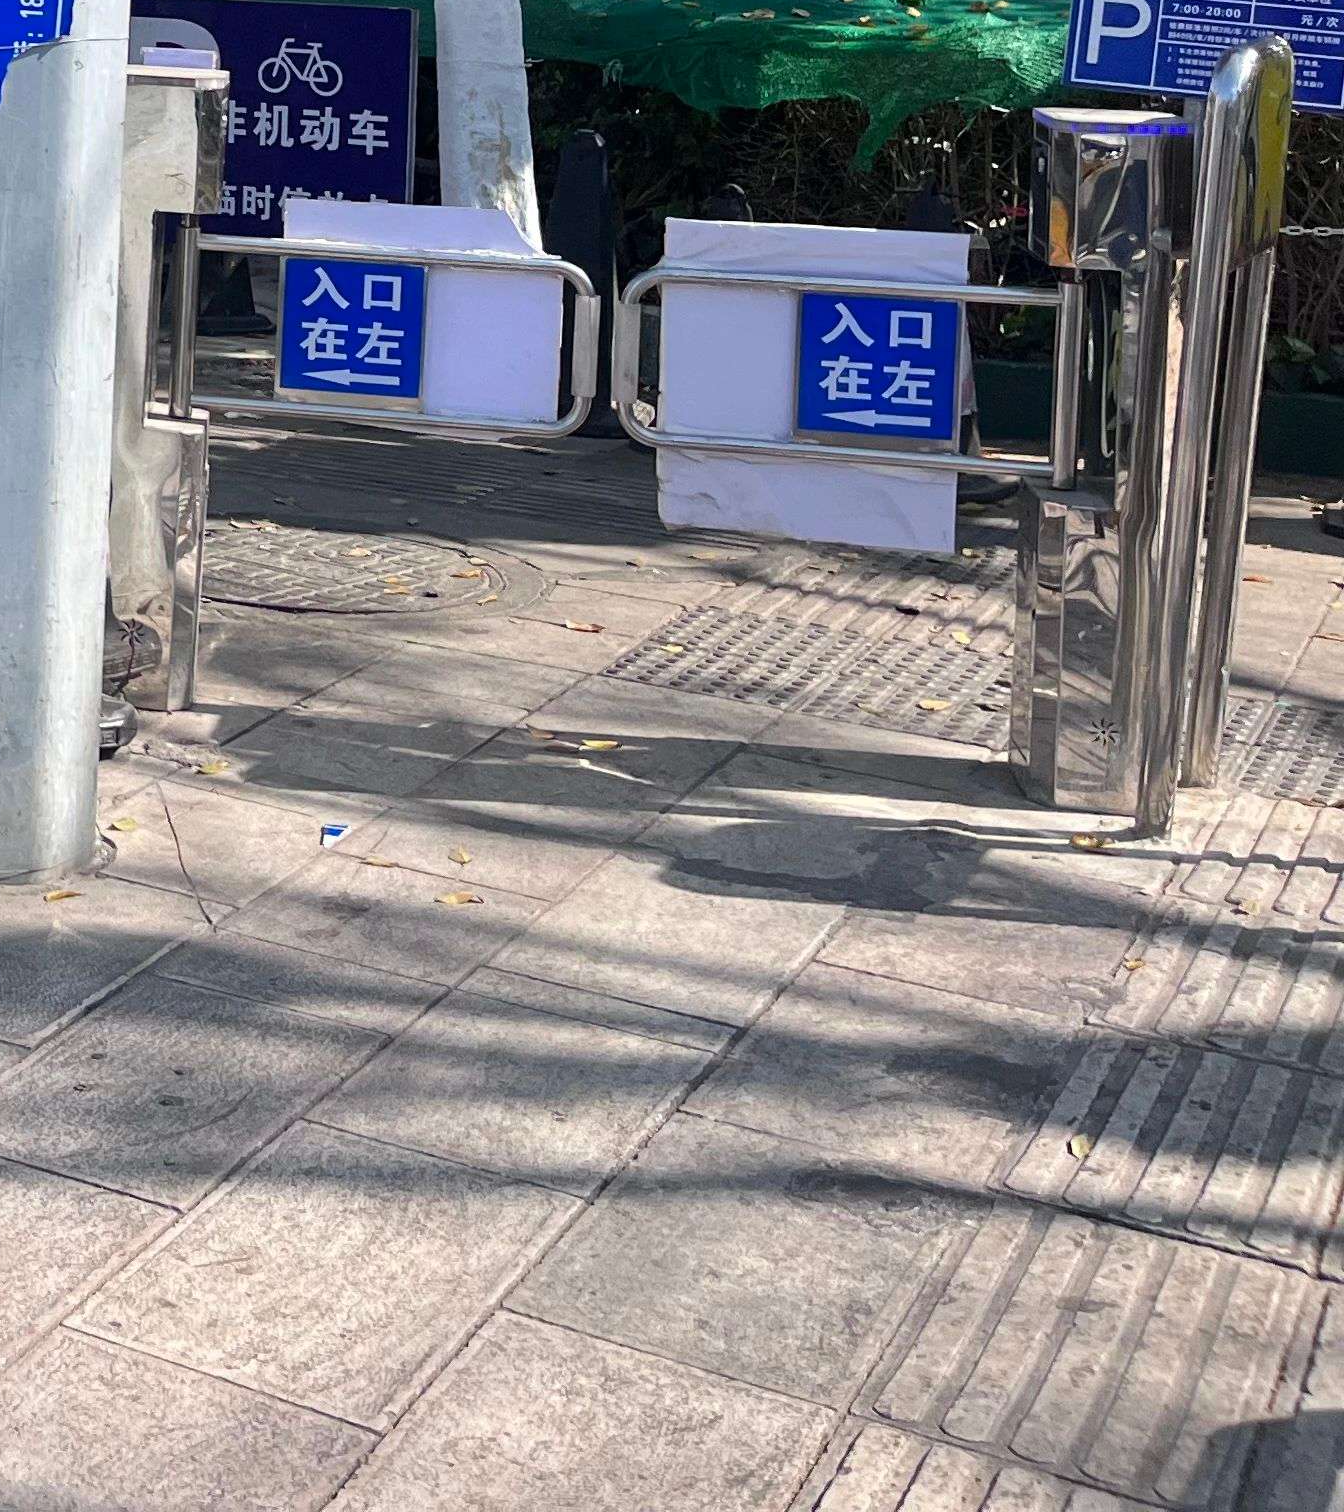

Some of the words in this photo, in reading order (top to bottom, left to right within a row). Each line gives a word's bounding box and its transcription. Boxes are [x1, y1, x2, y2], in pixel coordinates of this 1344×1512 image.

[301, 266, 403, 312] 入口
[300, 317, 404, 366] 在左
[820, 302, 933, 349] 入口
[818, 355, 935, 406] 在左
